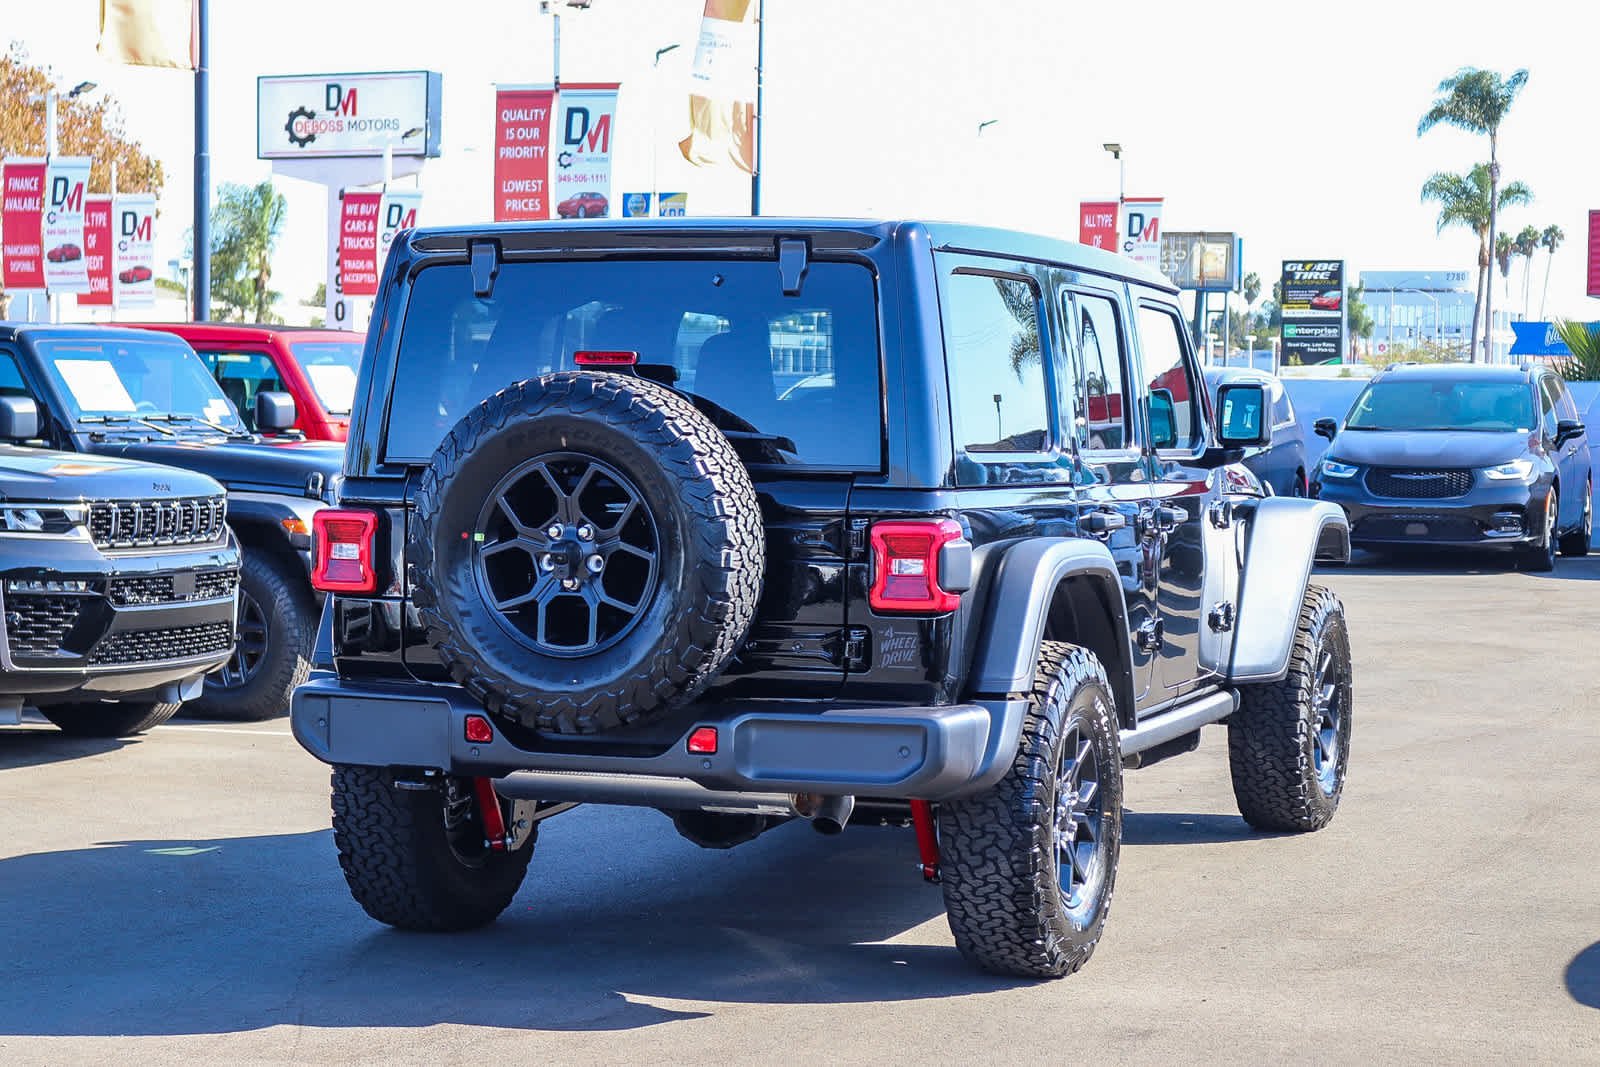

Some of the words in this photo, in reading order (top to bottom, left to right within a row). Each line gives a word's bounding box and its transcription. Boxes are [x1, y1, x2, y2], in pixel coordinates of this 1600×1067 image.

[502, 108, 546, 123] QUALITY
[347, 118, 400, 132] MOTORS
[564, 107, 611, 153] DM
[505, 128, 516, 141] IS
[517, 128, 540, 140] OUR
[500, 146, 546, 159] PRIORITY
[8, 177, 39, 191] FINANCE
[502, 180, 544, 193] LOWEST
[52, 177, 84, 213] DM
[4, 198, 41, 212] AVAILABLE
[345, 203, 359, 216] WE
[360, 203, 378, 215] BUY
[505, 198, 541, 212] PRICES
[91, 211, 108, 228] TYPE
[121, 211, 152, 242] DM
[344, 220, 366, 233] CARS
[1084, 214, 1097, 228] ALL
[1097, 214, 1113, 228] TYPE
[1127, 213, 1159, 242] DM
[87, 233, 97, 249] OF
[343, 236, 375, 249] TRUCKS
[1295, 271, 1331, 280] TIRE
[1286, 327, 1338, 336] enterprise
[881, 637, 917, 652] WHEEL
[881, 649, 915, 665] DRIVE
